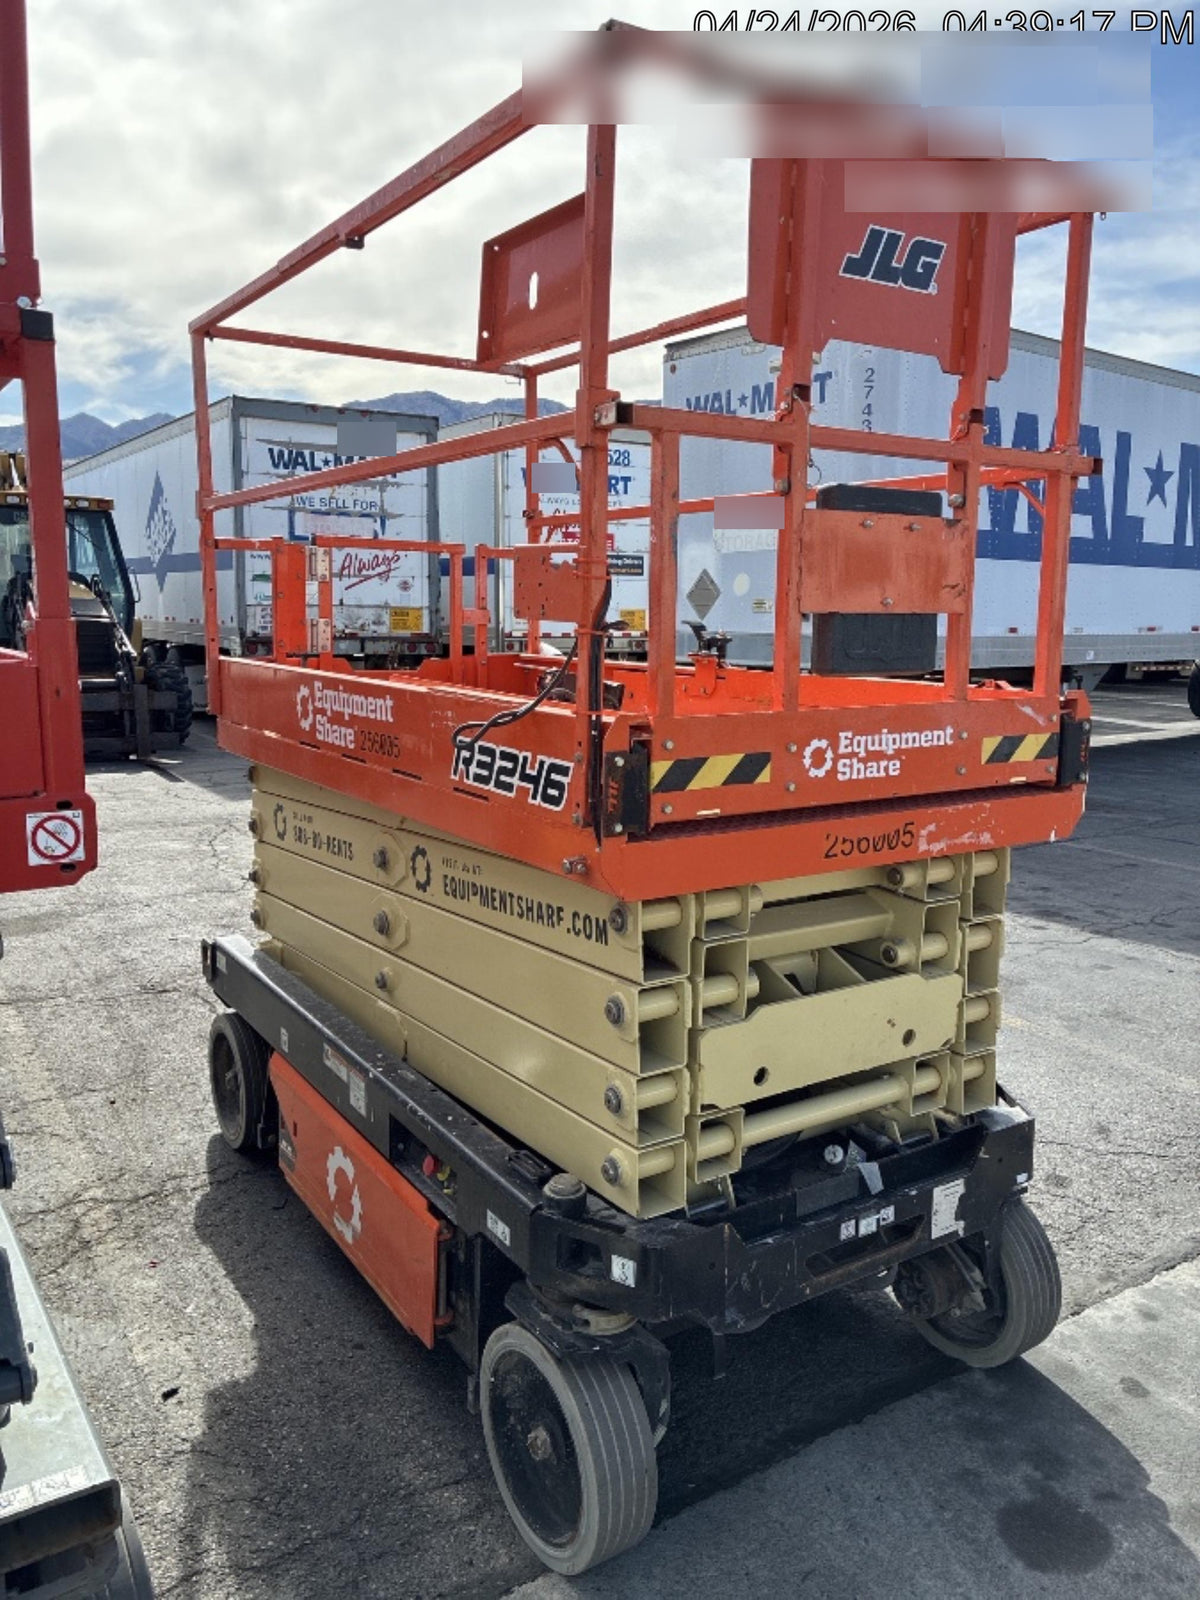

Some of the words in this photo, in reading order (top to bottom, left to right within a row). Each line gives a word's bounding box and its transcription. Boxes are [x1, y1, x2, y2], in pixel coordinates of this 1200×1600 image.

[839, 224, 946, 293] JLG
[686, 371, 833, 415] WALMT
[296, 496, 315, 508] WE
[353, 499, 378, 511] FOR
[339, 551, 401, 581] Always
[314, 681, 394, 722] Equipment
[316, 714, 355, 749] Share
[837, 725, 955, 757] Equipment
[450, 737, 574, 811] R3246
[837, 756, 901, 781] Share
